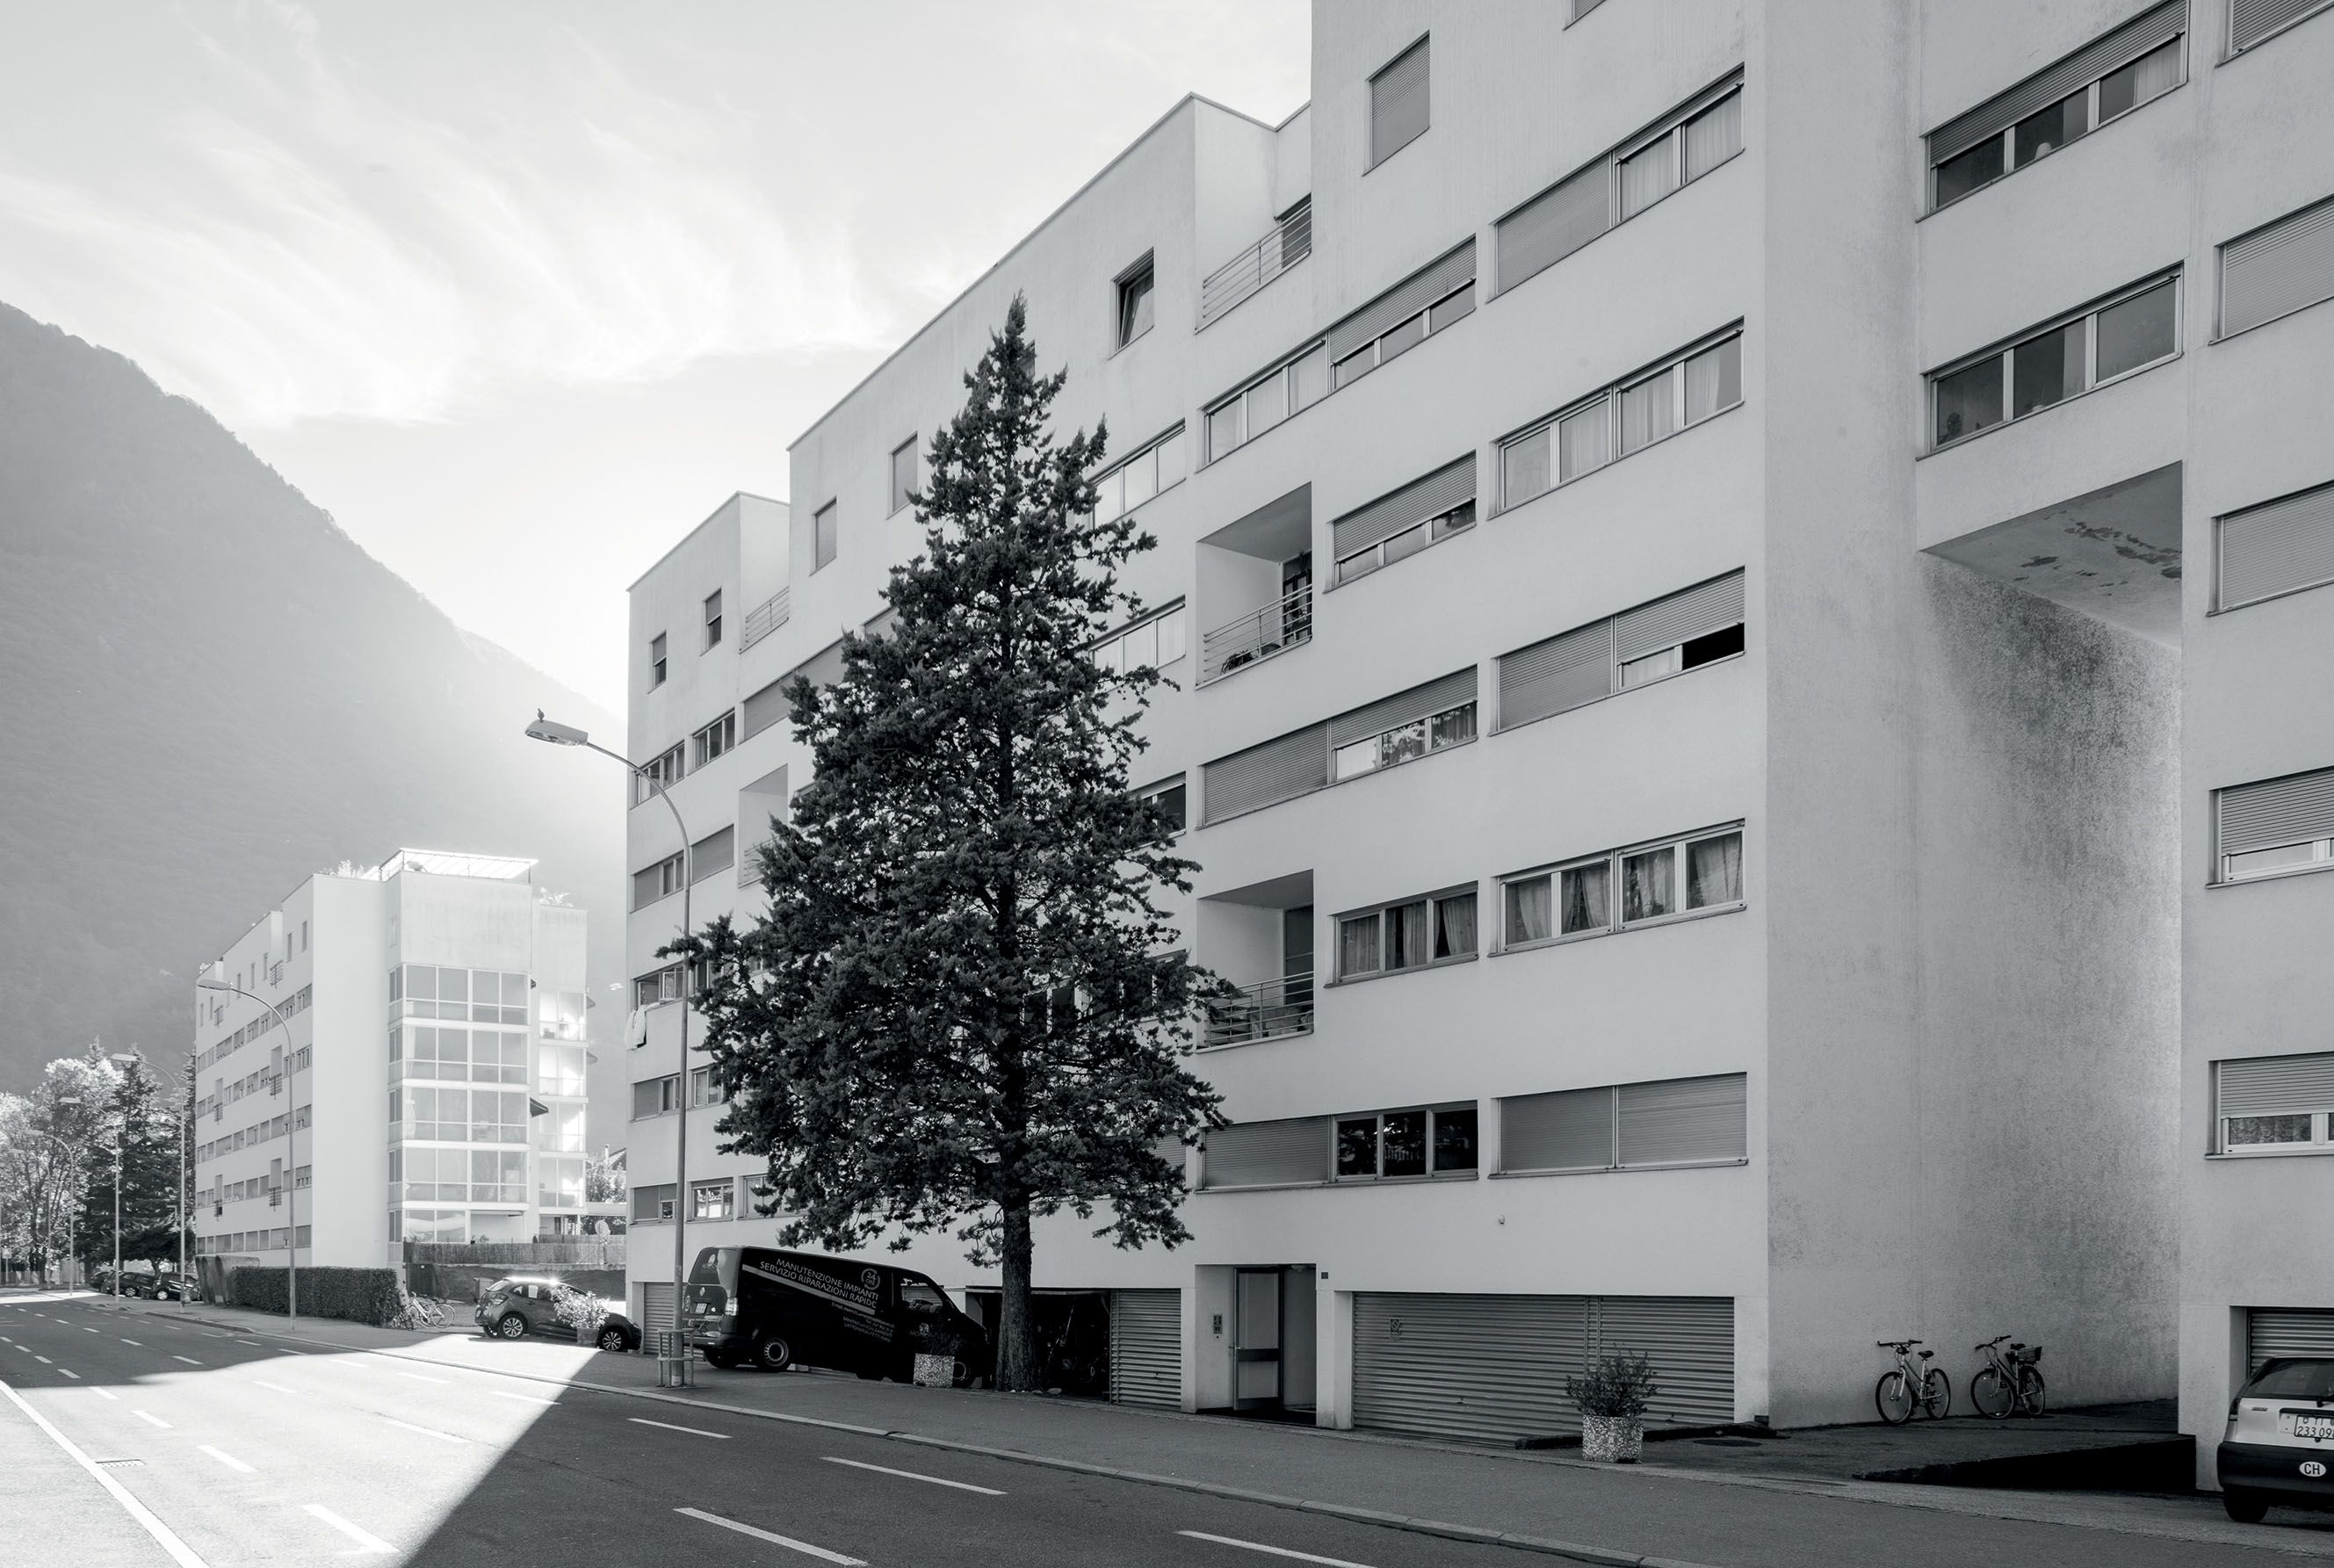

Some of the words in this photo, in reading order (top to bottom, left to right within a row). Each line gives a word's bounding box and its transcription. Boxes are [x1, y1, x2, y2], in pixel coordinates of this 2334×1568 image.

[776, 1258, 843, 1288] MANUTENZIONE
[843, 1282, 879, 1301] IMPIANTI
[867, 1272, 877, 1281] 24
[759, 1261, 798, 1280] SERVIZIO
[798, 1274, 849, 1298] RIPARAZIONI
[849, 1292, 878, 1309] RAPIDE
[2297, 1426, 2316, 1436] 233
[2304, 1463, 2320, 1475] CH
